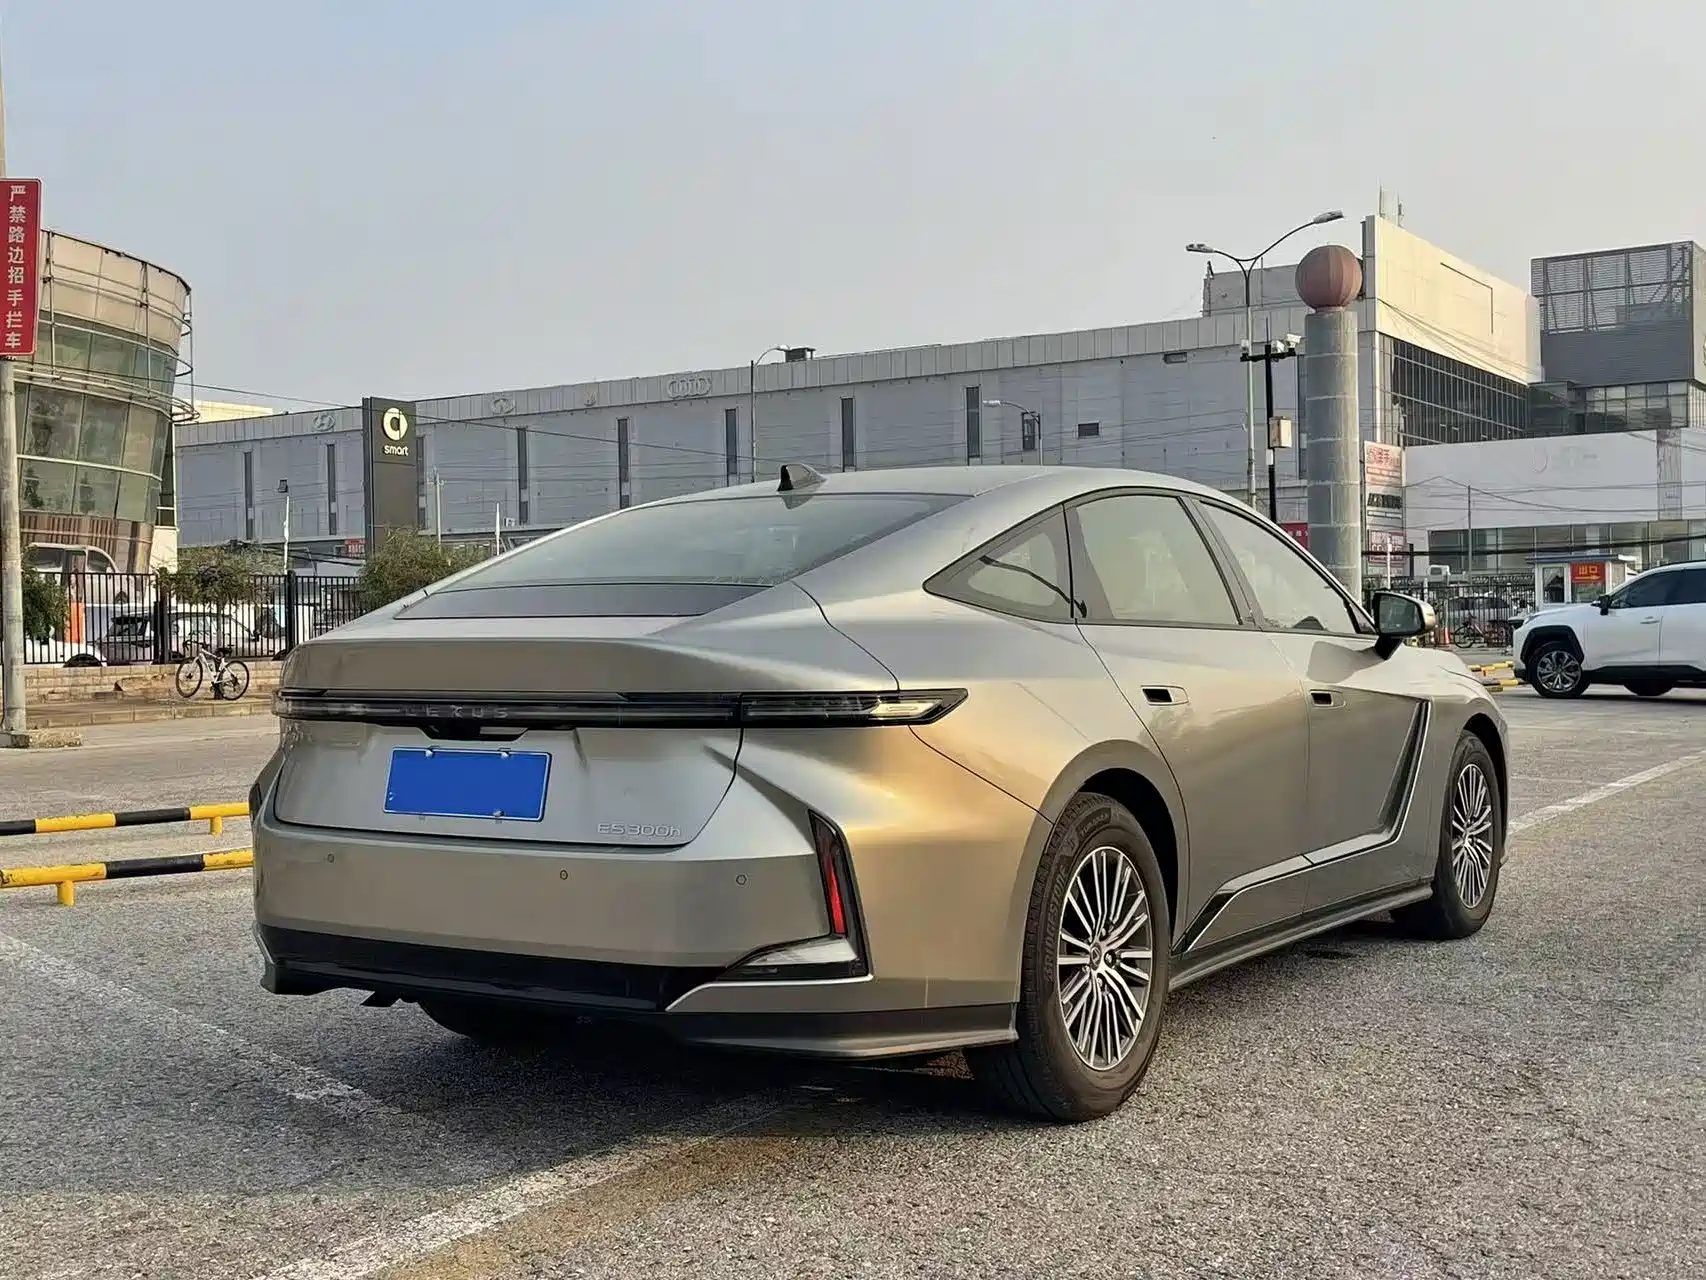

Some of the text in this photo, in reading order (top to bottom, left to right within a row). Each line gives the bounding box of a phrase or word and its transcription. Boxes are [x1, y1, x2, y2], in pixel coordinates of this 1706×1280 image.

[5, 185, 26, 349] 严禁路边招手拦车
[384, 445, 409, 456] smart
[1578, 565, 1598, 575] 出口
[405, 704, 509, 719] LEXUS
